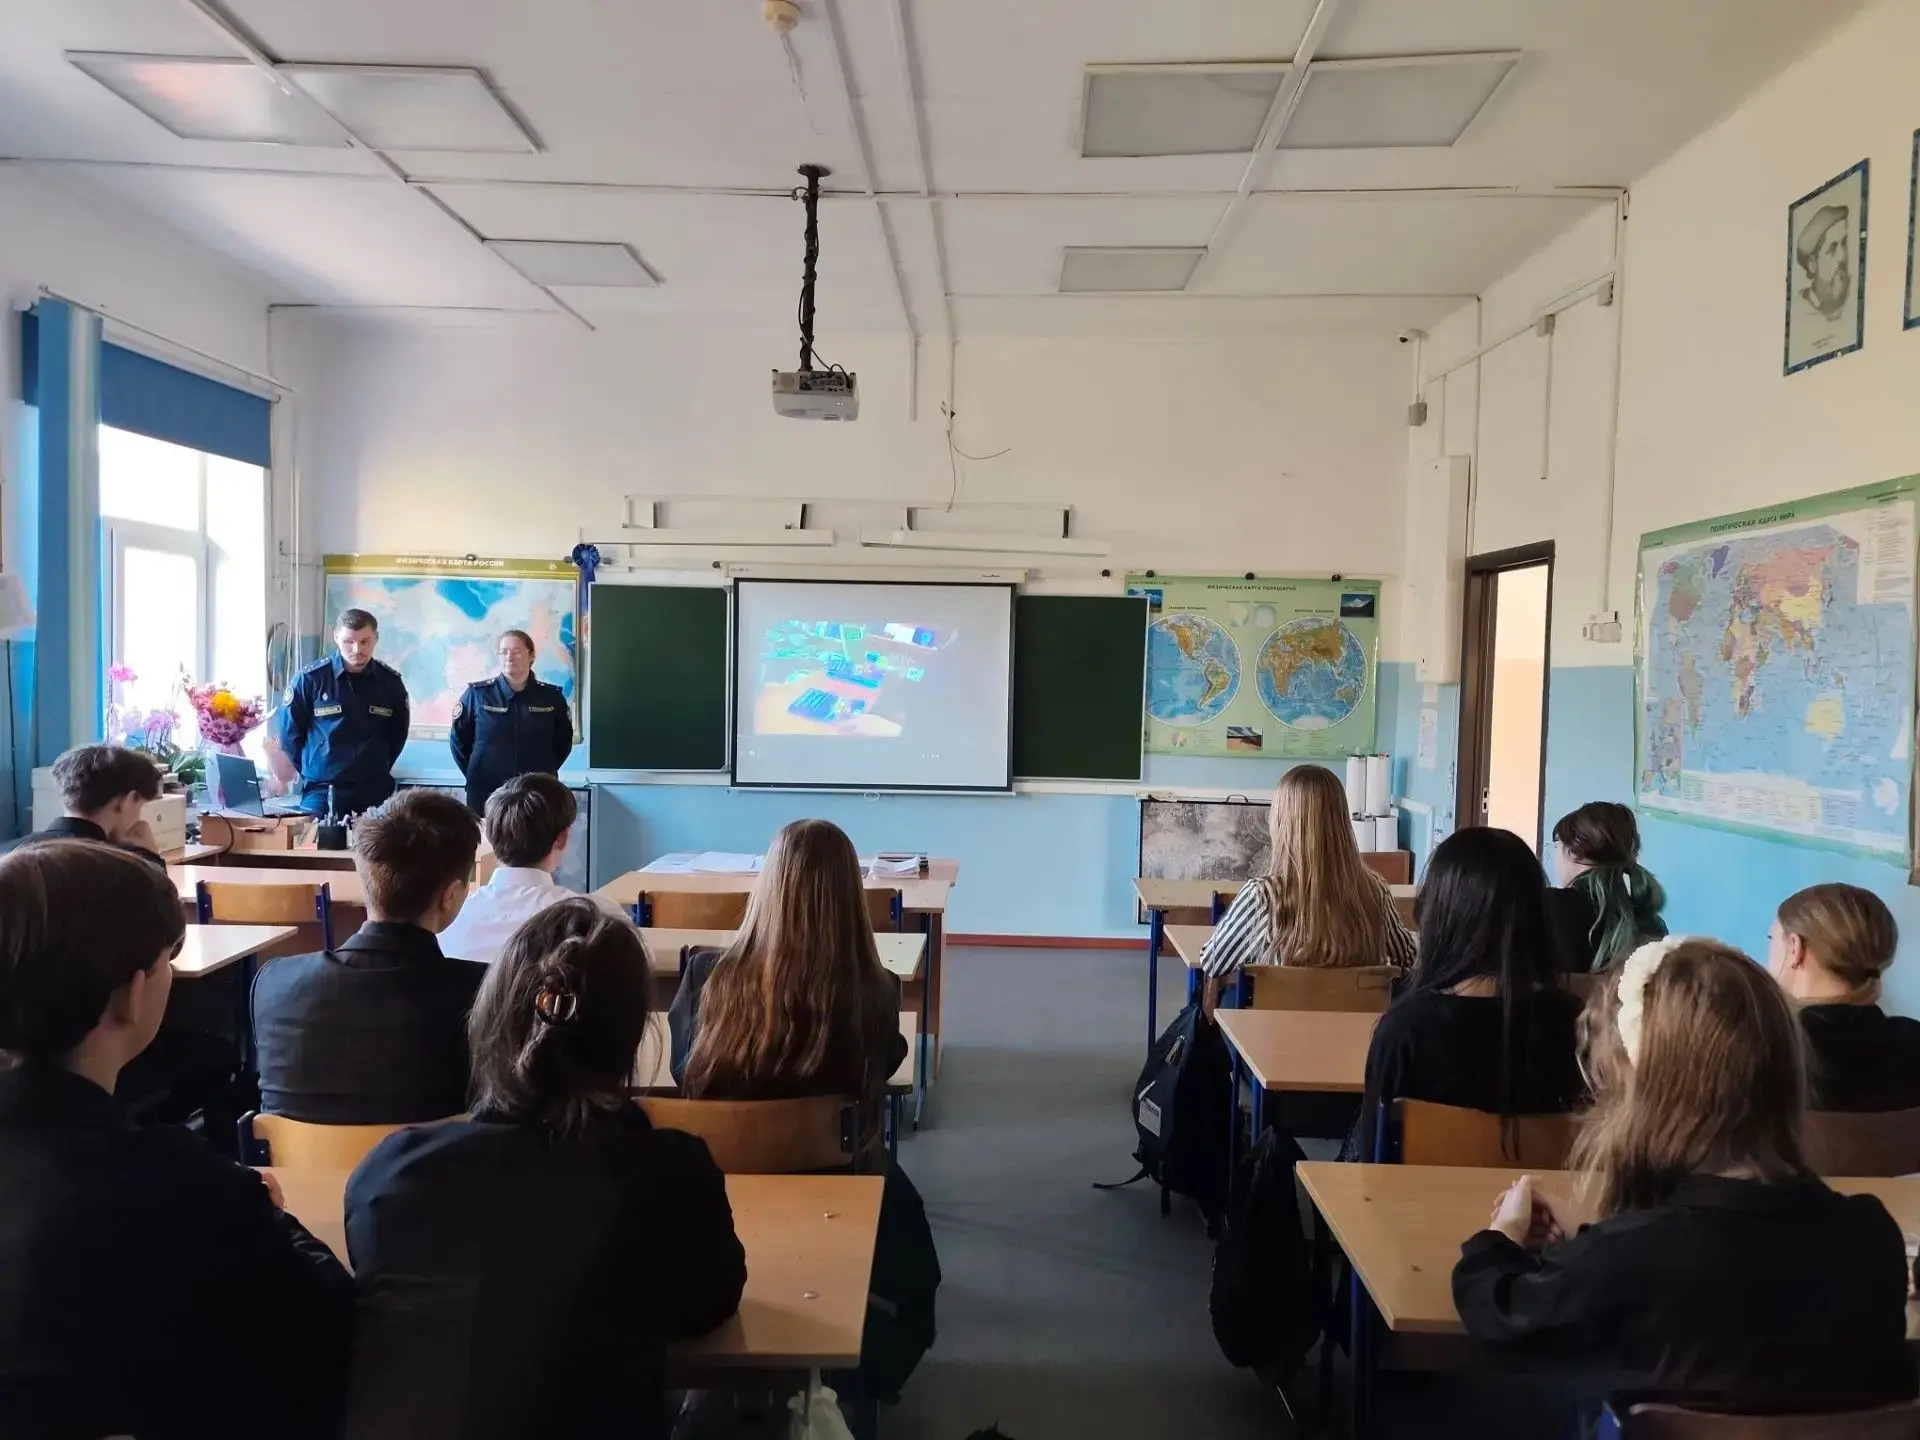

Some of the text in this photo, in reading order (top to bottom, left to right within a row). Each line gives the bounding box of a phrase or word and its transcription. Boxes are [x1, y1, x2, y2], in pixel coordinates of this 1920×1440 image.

[1710, 511, 1795, 533] ПОЛИТИЧЕСКАЯ КАРТА МИРА
[395, 557, 505, 567] ФИЗИЧЕСКАЯ КАРТА РОССИИ
